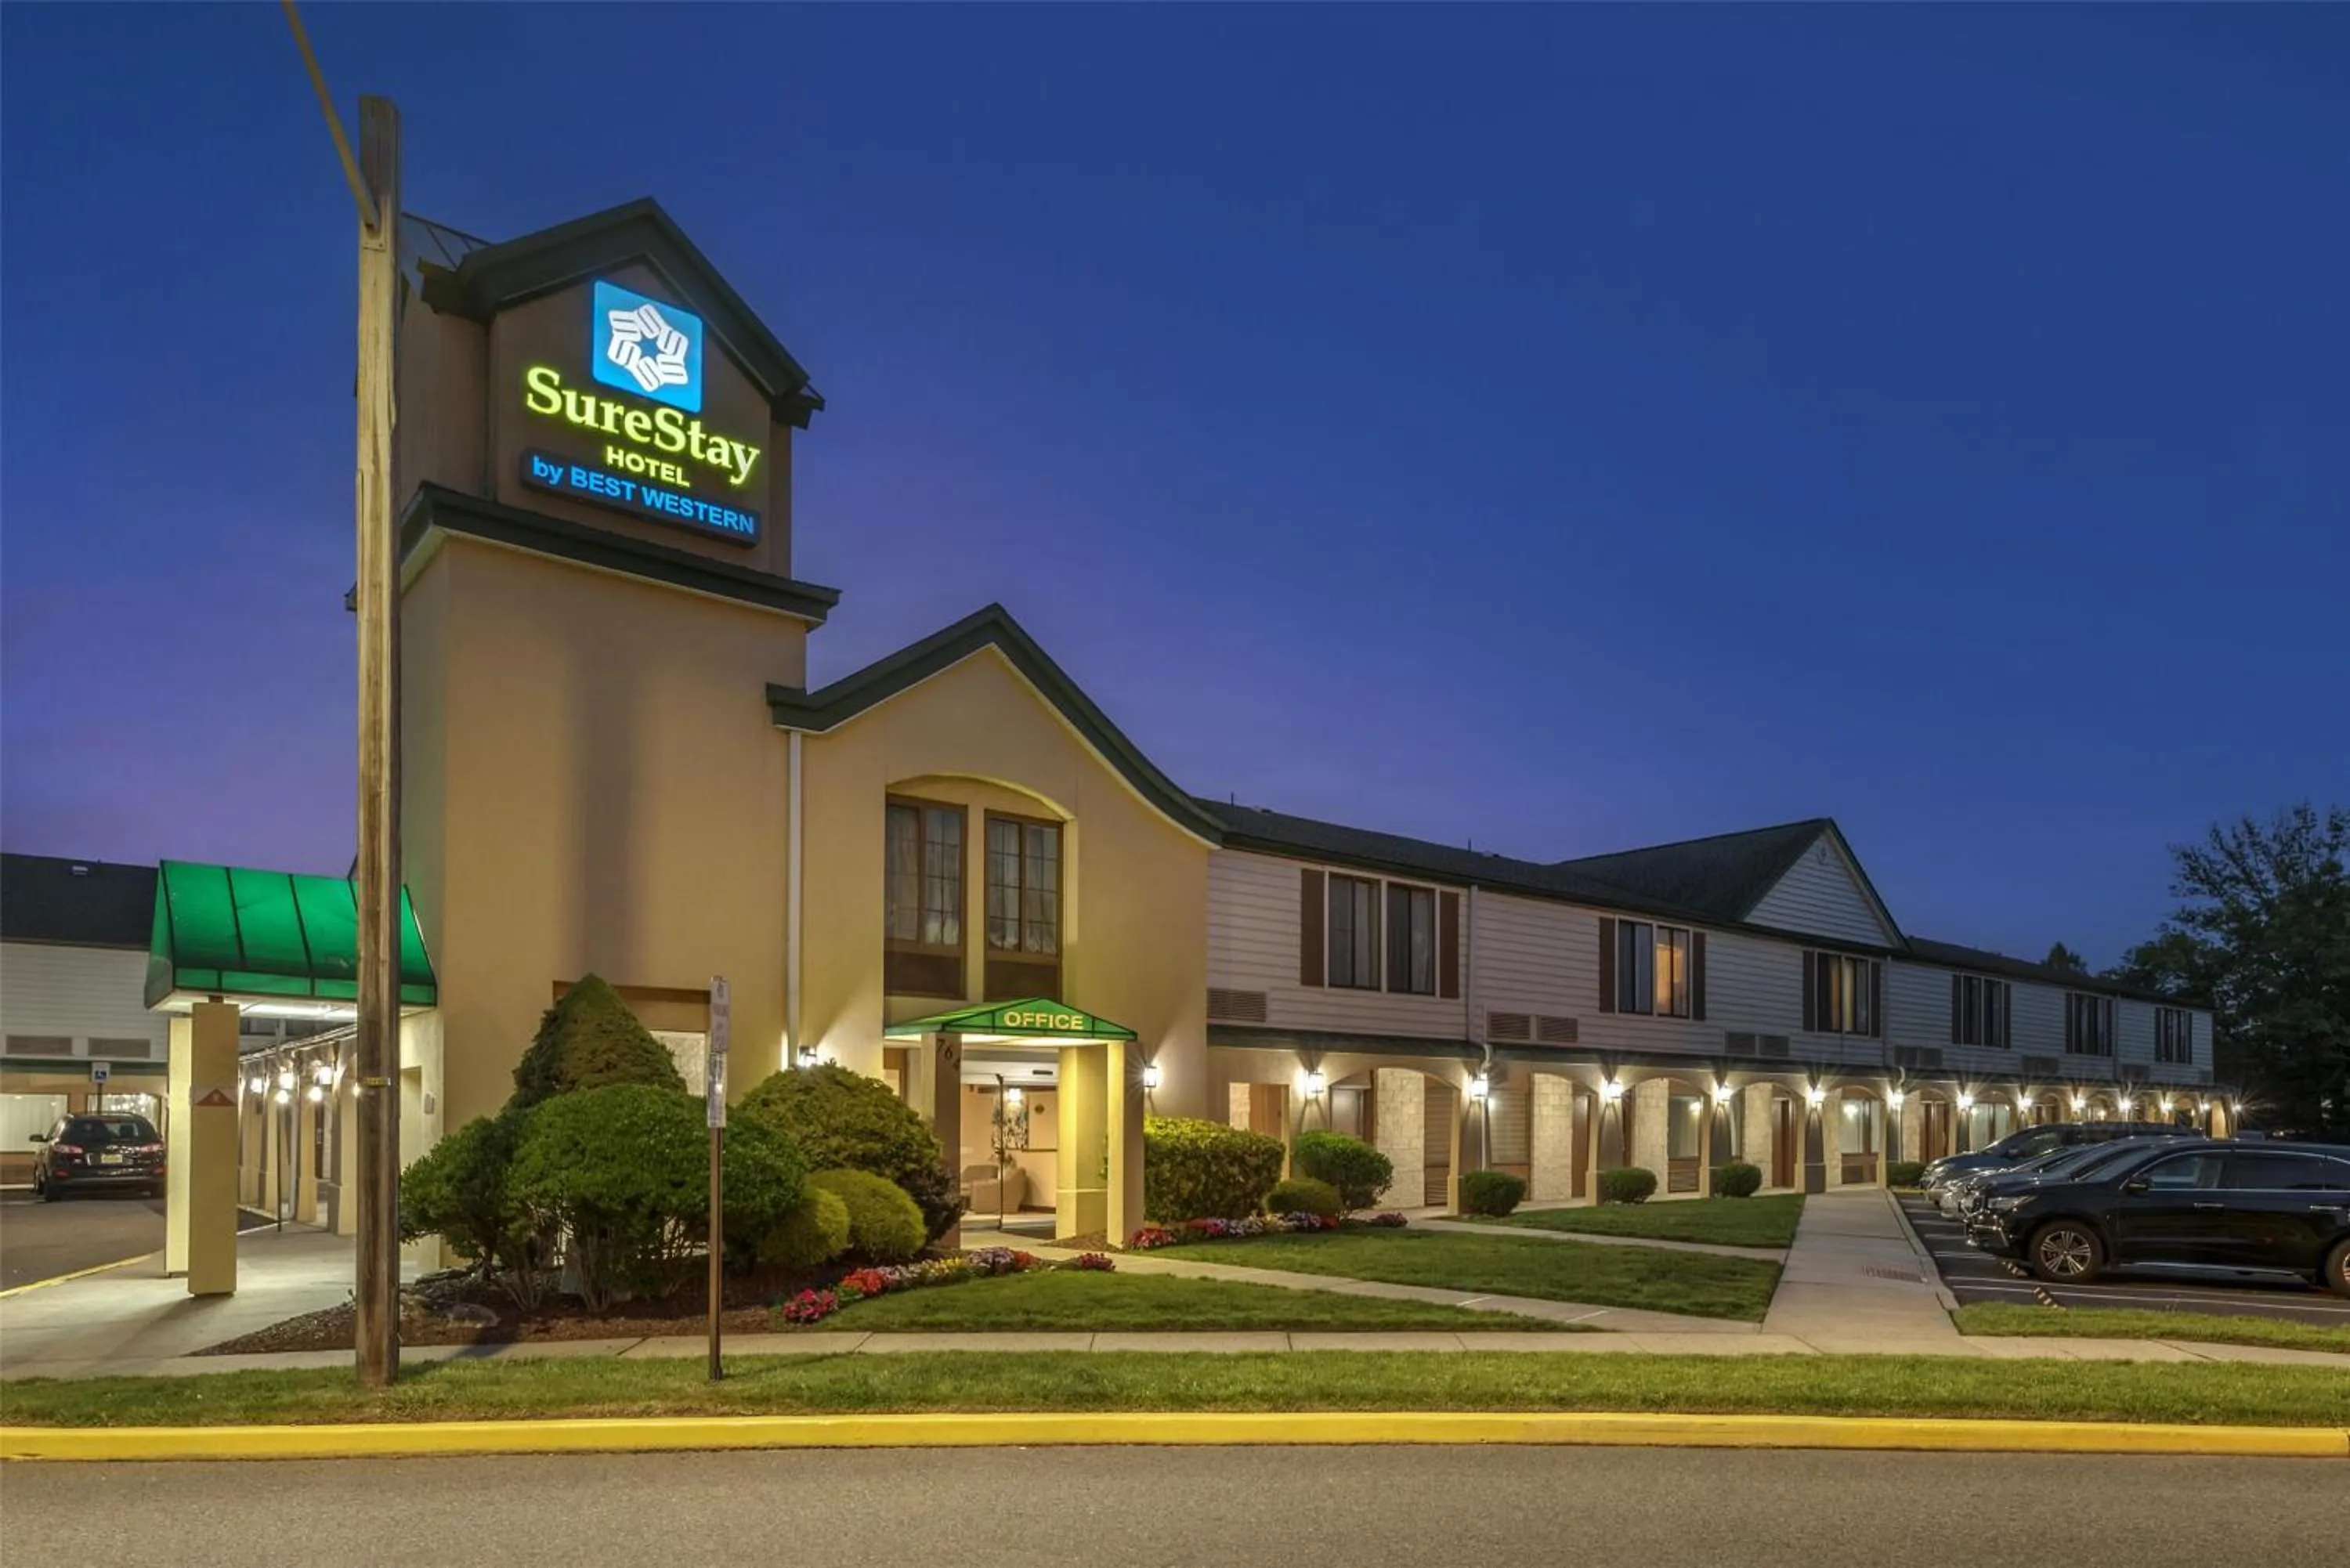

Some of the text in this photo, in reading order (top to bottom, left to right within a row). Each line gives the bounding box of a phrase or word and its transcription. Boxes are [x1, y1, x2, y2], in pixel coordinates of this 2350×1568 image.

[526, 366, 761, 486] SureStay
[533, 454, 755, 535] by BEST WESTERN
[606, 444, 691, 489] HOTEL
[1003, 1011, 1084, 1030] OFFICE
